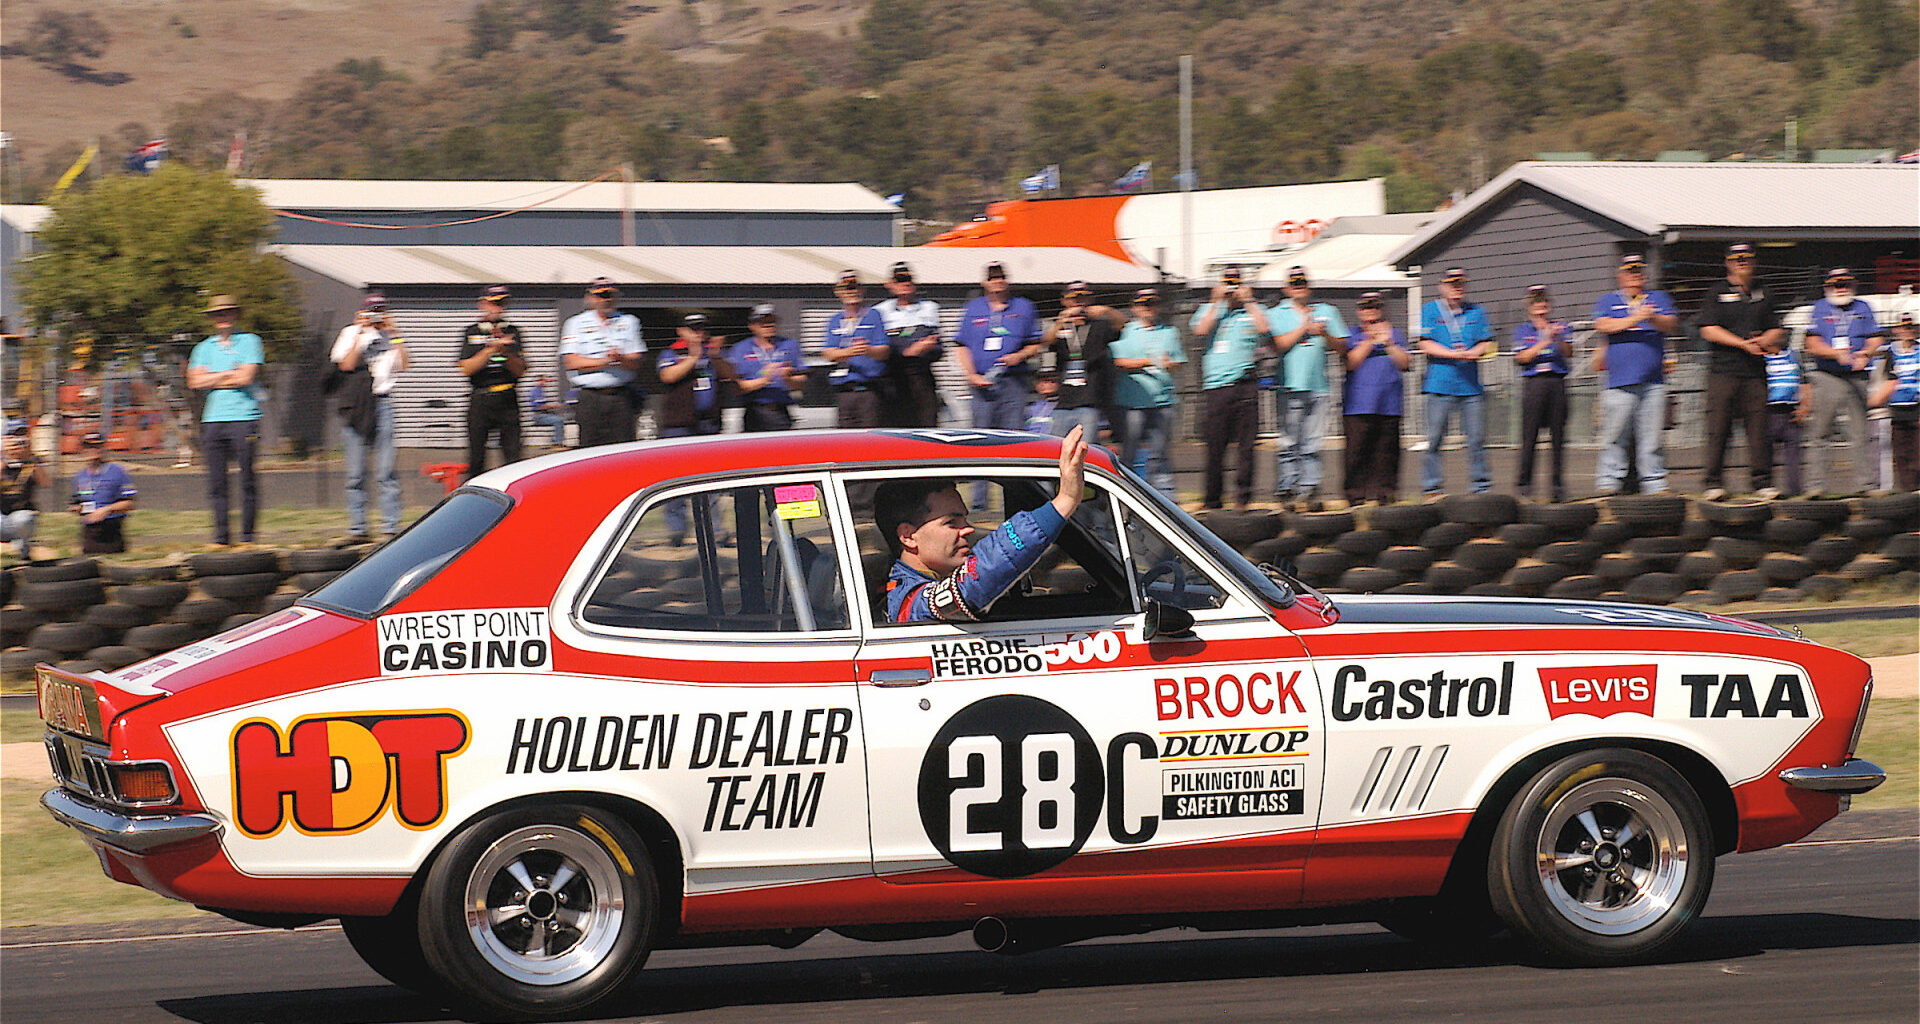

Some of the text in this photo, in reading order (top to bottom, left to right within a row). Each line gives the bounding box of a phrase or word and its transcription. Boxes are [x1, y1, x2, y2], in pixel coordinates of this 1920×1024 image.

[381, 612, 544, 638] WREST POINT
[384, 639, 547, 671] CASINO
[934, 654, 1043, 677] FERODO
[1044, 631, 1121, 666] 500
[1154, 670, 1306, 721] BROCK
[1332, 661, 1514, 721] Castrol
[1681, 674, 1809, 718] TAA
[506, 708, 853, 774] HOLDEN DEALER
[1160, 731, 1309, 758] DUNLOP
[230, 708, 472, 840] HDT
[1170, 769, 1297, 792] PILKINGTON ACI
[703, 772, 825, 832] TEAM
[1176, 792, 1289, 817] SAFETY GLASS
